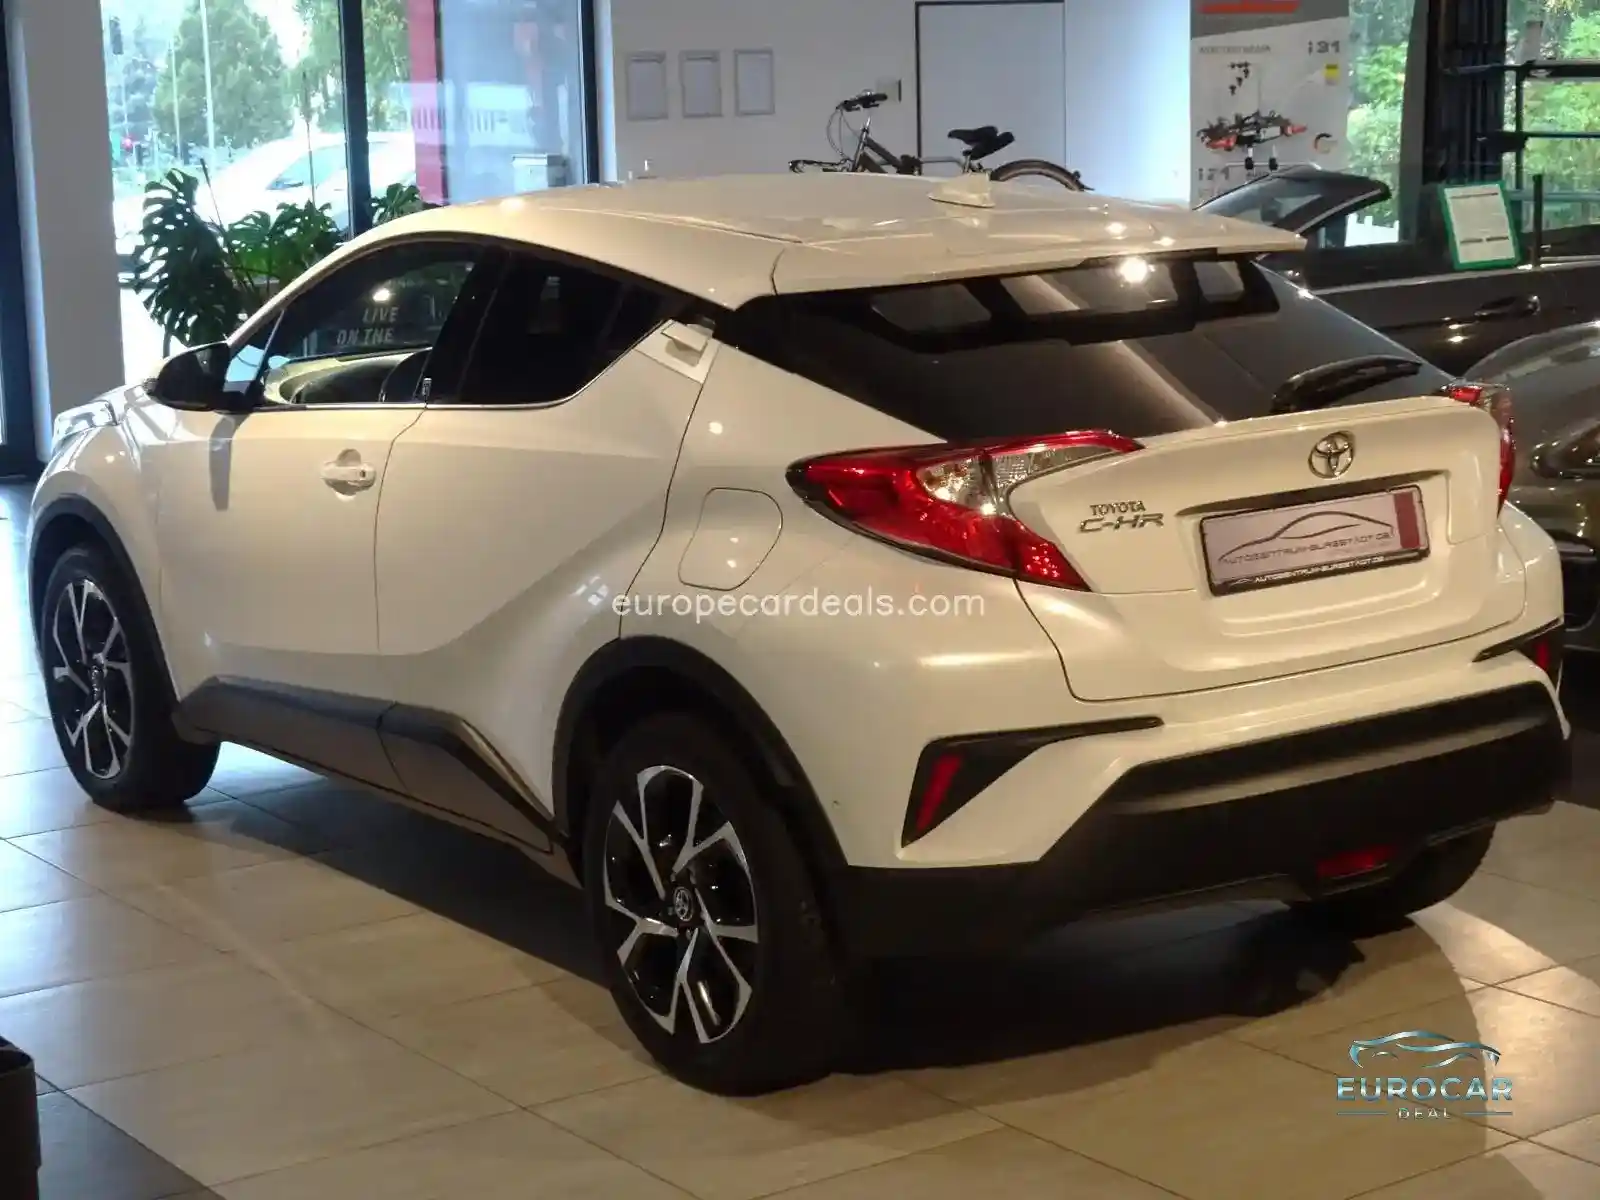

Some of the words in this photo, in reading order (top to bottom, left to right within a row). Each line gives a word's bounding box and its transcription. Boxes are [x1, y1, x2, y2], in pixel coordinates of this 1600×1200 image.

[362, 306, 399, 322] LIVE
[336, 329, 360, 345] ON
[1089, 500, 1147, 516] TOYOTA
[1079, 513, 1165, 534] C-HR
